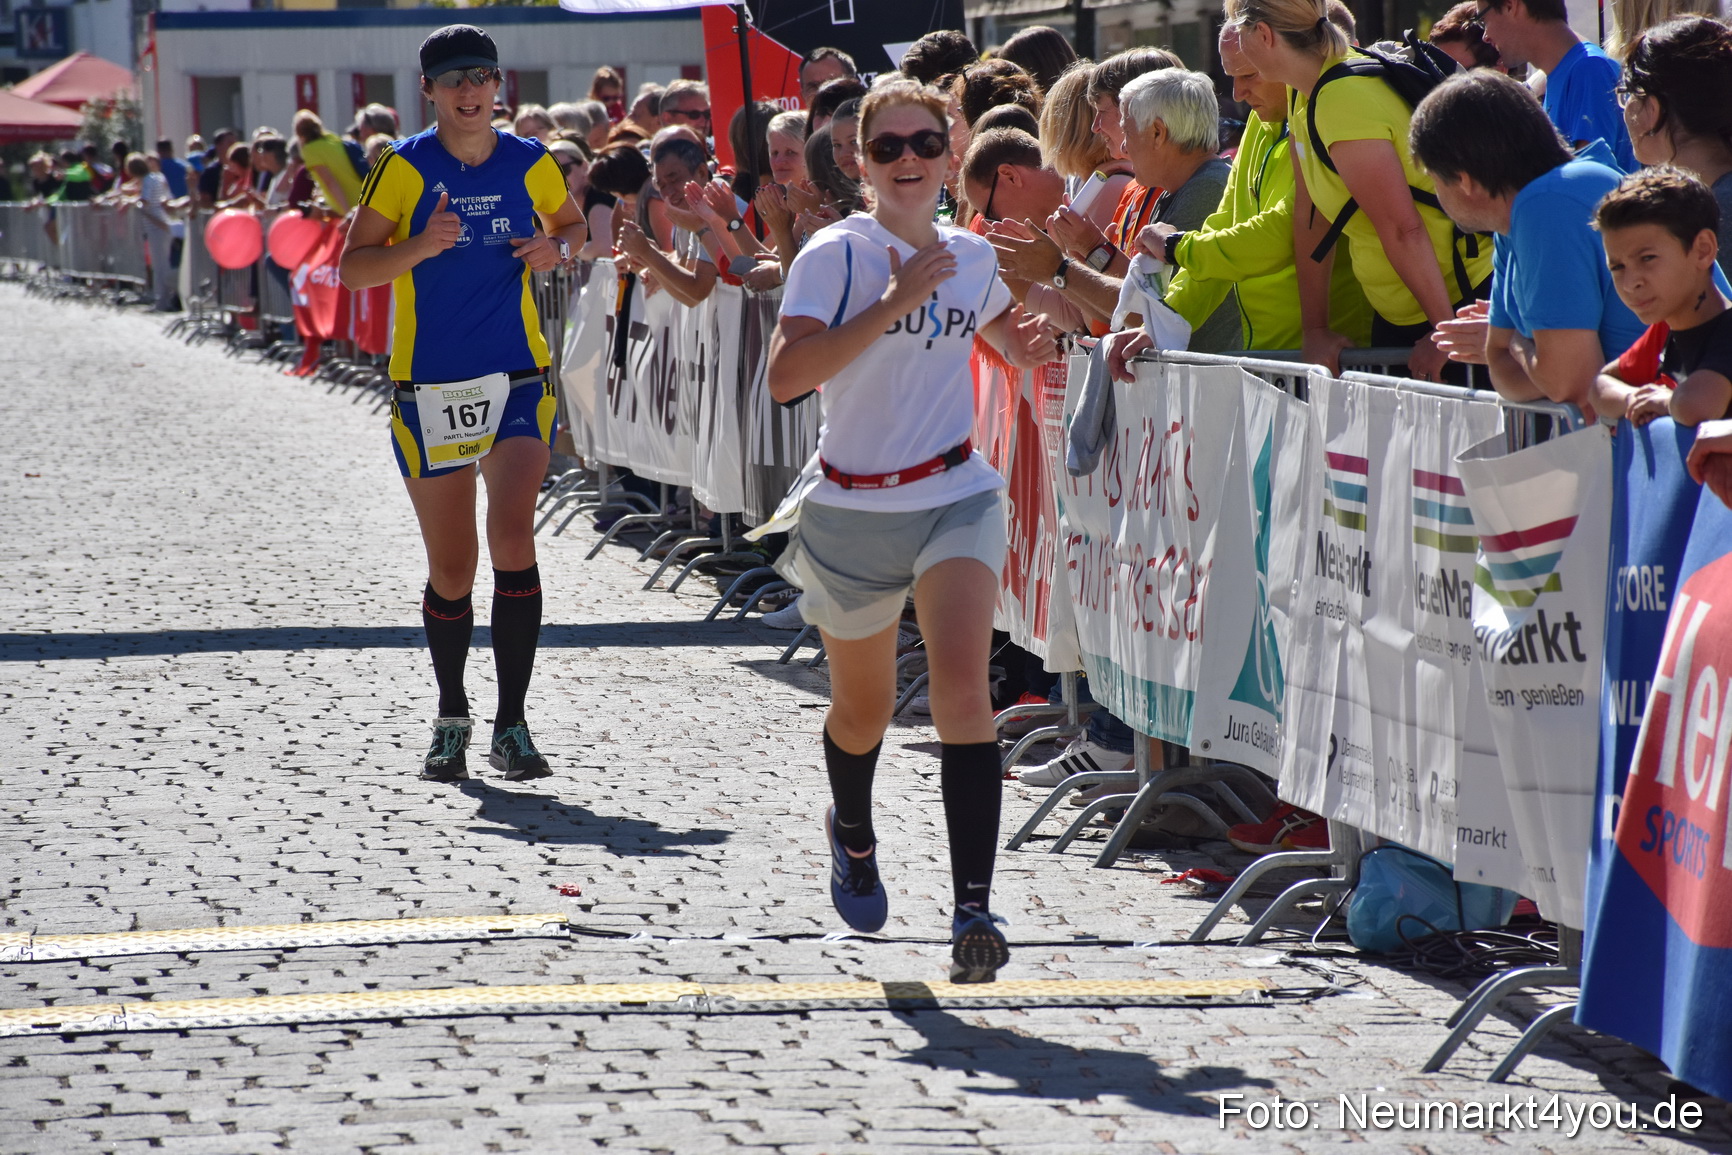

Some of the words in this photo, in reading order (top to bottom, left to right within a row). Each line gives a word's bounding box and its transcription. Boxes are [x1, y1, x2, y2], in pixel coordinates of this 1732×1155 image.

[459, 195, 502, 204] INTERSPORT
[461, 202, 496, 212] LANGE
[491, 217, 512, 234] FR
[442, 386, 484, 399] BOCK
[442, 399, 491, 431] 167
[1615, 564, 1667, 613] STORE
[1223, 714, 1250, 744] Jura
[1640, 804, 1711, 881] SPORTS
